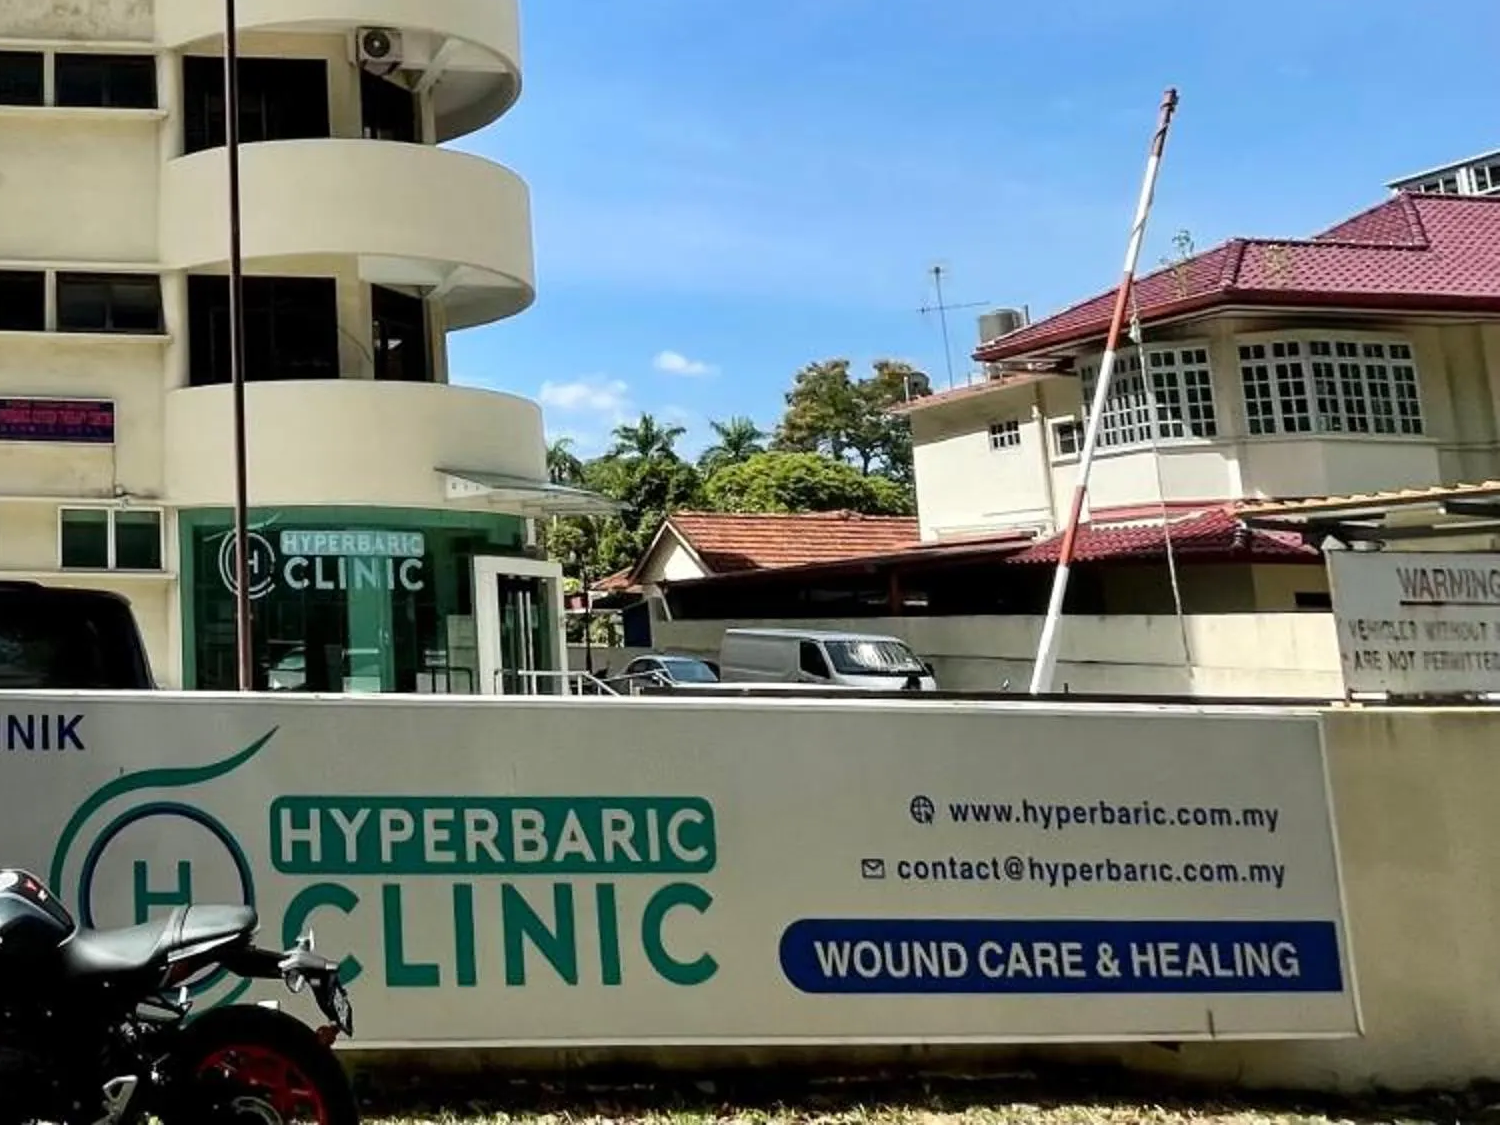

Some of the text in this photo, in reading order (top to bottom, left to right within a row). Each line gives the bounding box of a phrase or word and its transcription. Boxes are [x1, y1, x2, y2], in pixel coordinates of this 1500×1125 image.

[283, 533, 423, 554] HYPERBARIC
[284, 556, 424, 591] CLINIC
[1396, 567, 1500, 600] WARNING
[1354, 650, 1382, 672] ARE
[1388, 650, 1415, 672] NOT
[949, 799, 1278, 833] www.hyperbaric.com.my
[280, 807, 708, 864] HYPERBARIC
[897, 856, 1285, 889] contact@hyperbaric.com.my
[282, 882, 720, 987] CLINIC
[814, 940, 1299, 978] WOUND CARE & HEALING
